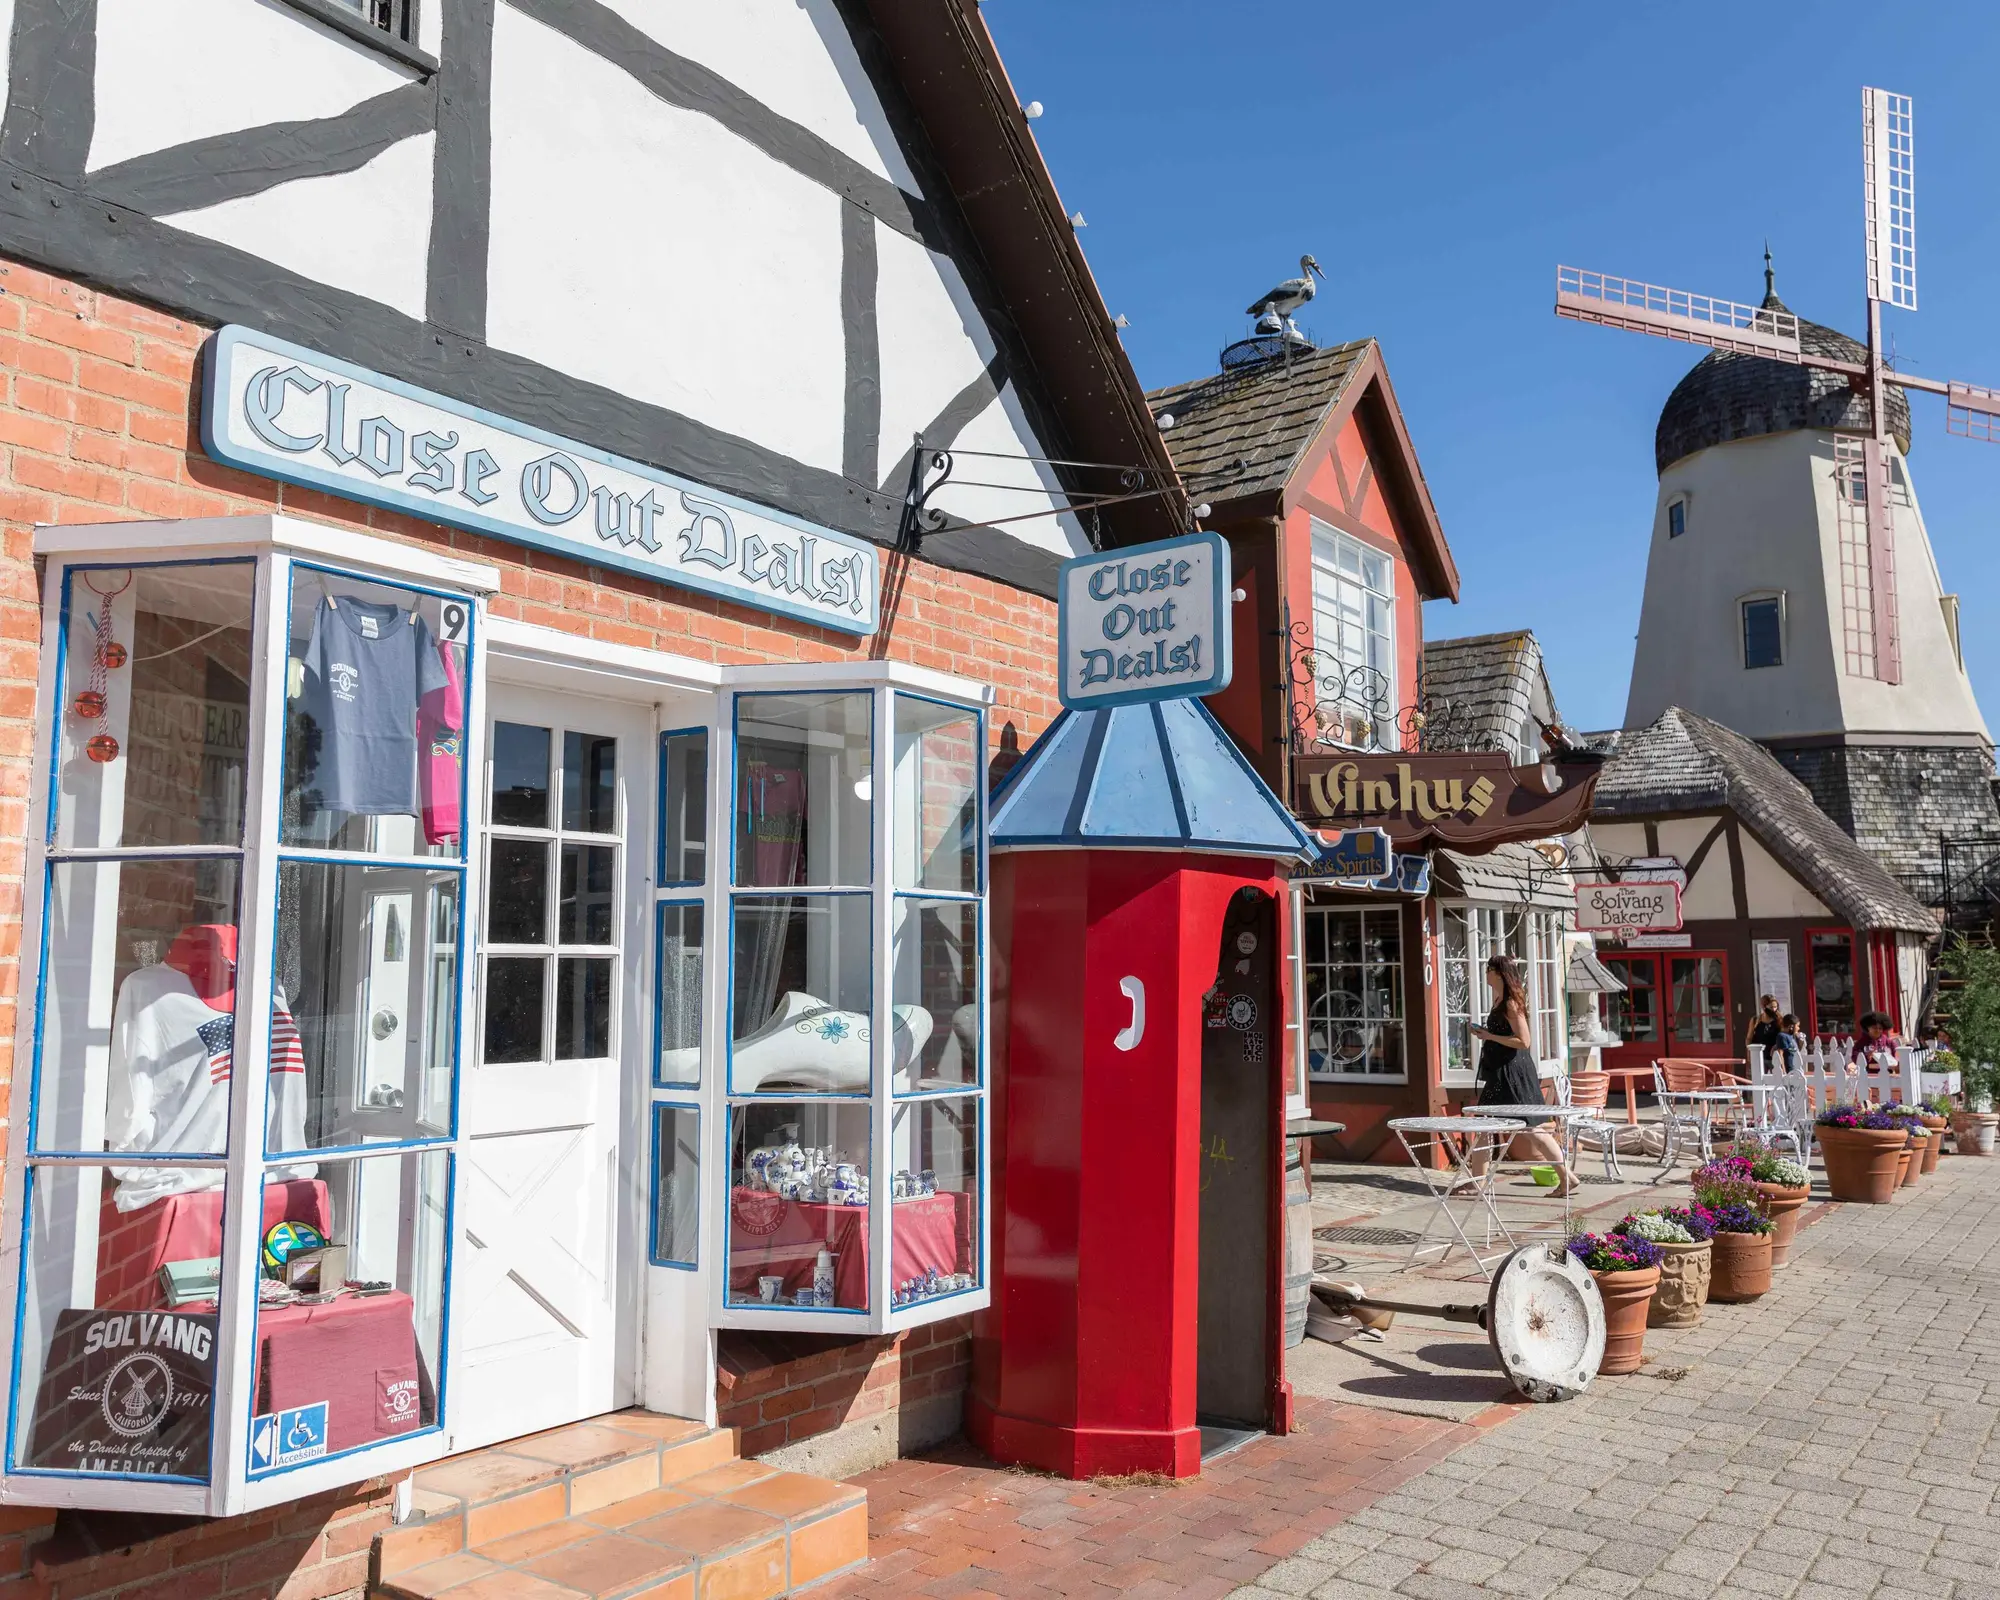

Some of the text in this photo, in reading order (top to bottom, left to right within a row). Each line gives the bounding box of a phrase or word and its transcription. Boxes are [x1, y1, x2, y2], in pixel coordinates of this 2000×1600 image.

[243, 365, 865, 616] Close Out Deals!
[1088, 558, 1191, 602] Close
[443, 604, 466, 641] 9
[1102, 597, 1177, 641] Out
[1080, 634, 1201, 689] Deals!
[1309, 761, 1497, 821] Vinhus
[1336, 852, 1383, 879] Spirits
[1591, 891, 1664, 914] Solvang
[1619, 888, 1636, 896] The
[1600, 909, 1655, 927] Bakery
[1422, 916, 1433, 986] 440
[83, 1313, 213, 1362] SOLVANG
[67, 1386, 209, 1408] Since 1911
[386, 1379, 418, 1397] SOLVANG
[114, 1411, 155, 1429] CALIFORNIA
[67, 1439, 190, 1462] the Danish Capital of
[277, 1446, 326, 1466] Accessible
